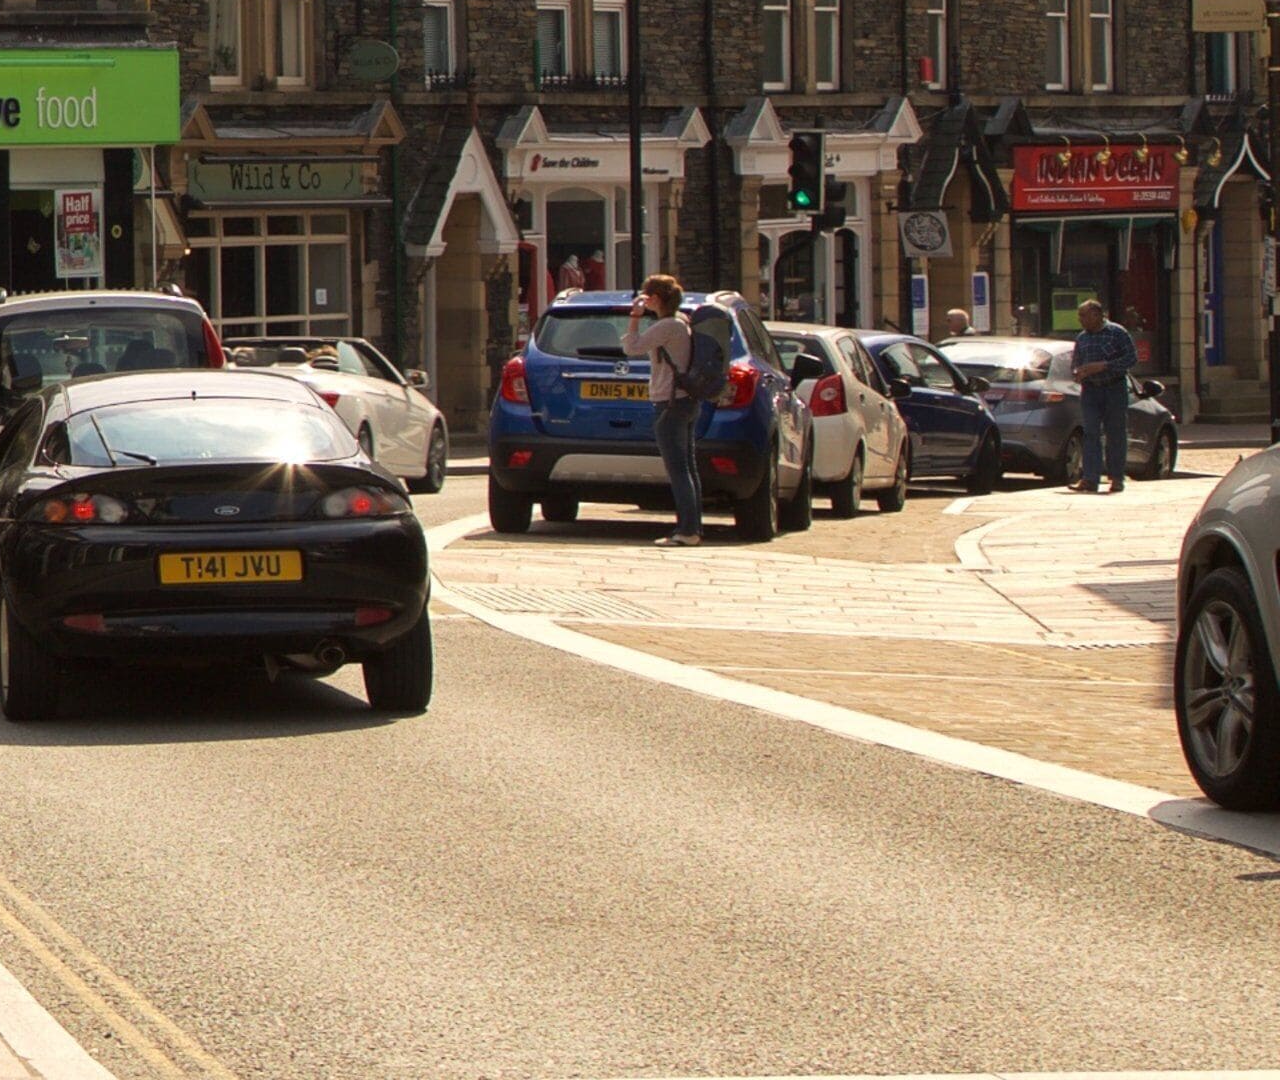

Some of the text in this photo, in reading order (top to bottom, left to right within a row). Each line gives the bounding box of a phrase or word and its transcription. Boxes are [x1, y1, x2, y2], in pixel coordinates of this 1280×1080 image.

[36, 86, 98, 130] food
[542, 156, 600, 169] Save the Children
[229, 163, 322, 190] Wild & Co
[66, 195, 90, 213] Half
[66, 213, 90, 228] price
[626, 384, 649, 398] WV
[235, 555, 282, 577] JVU
